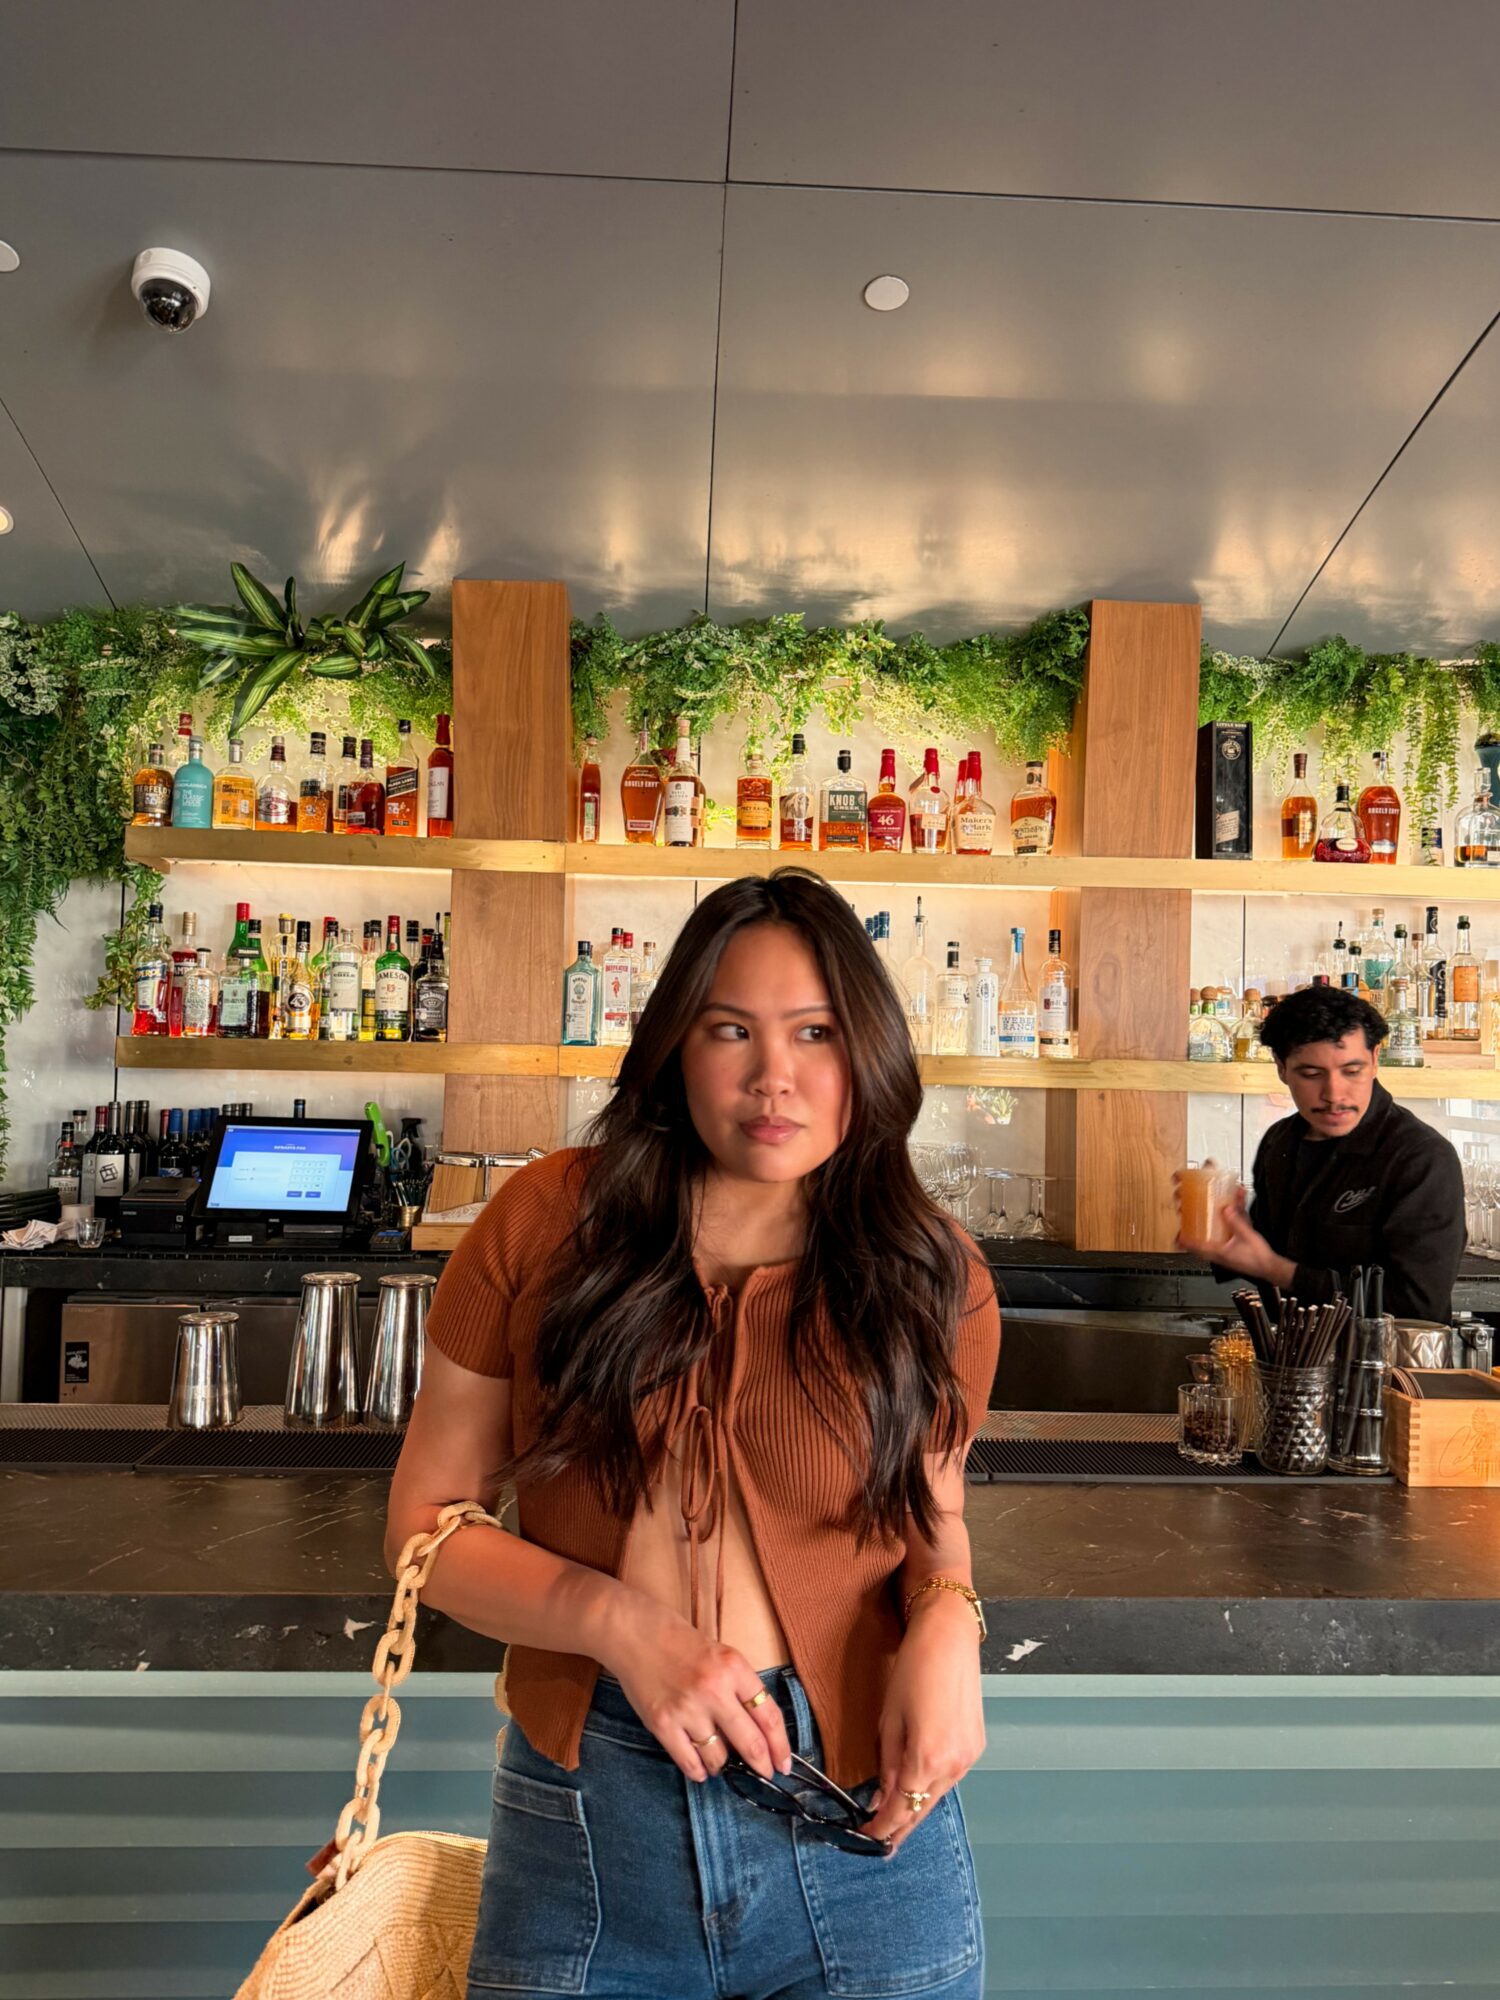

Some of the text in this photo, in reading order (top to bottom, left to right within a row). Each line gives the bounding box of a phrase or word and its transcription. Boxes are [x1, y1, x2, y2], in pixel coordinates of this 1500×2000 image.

[829, 794, 856, 806] KNOB
[878, 815, 895, 826] 46
[960, 816, 993, 824] Maker's
